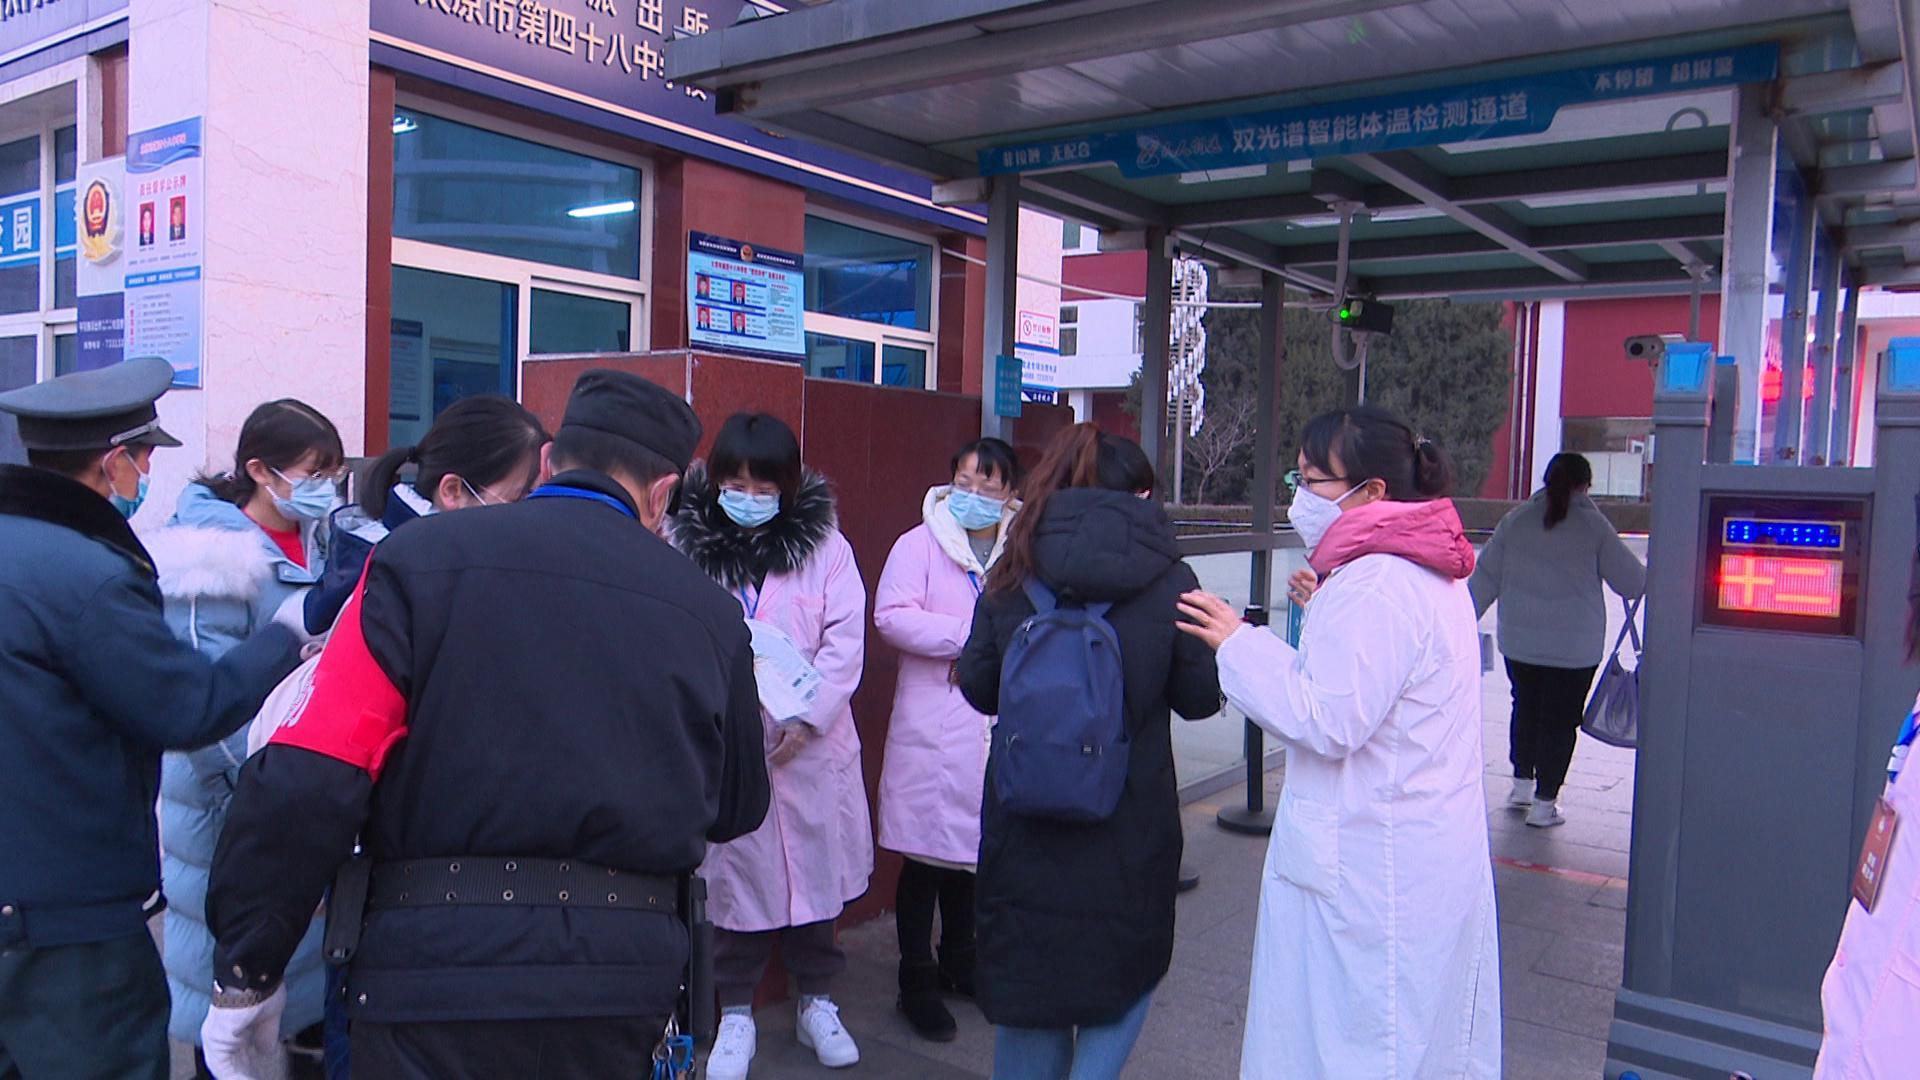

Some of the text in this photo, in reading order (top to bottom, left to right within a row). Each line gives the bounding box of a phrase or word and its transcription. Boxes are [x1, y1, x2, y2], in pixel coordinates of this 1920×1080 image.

[417, 0, 708, 100] 原市第四十八中
[1232, 92, 1528, 153] 双光谱智能体温检测通道
[1723, 557, 1834, 606] 十二
